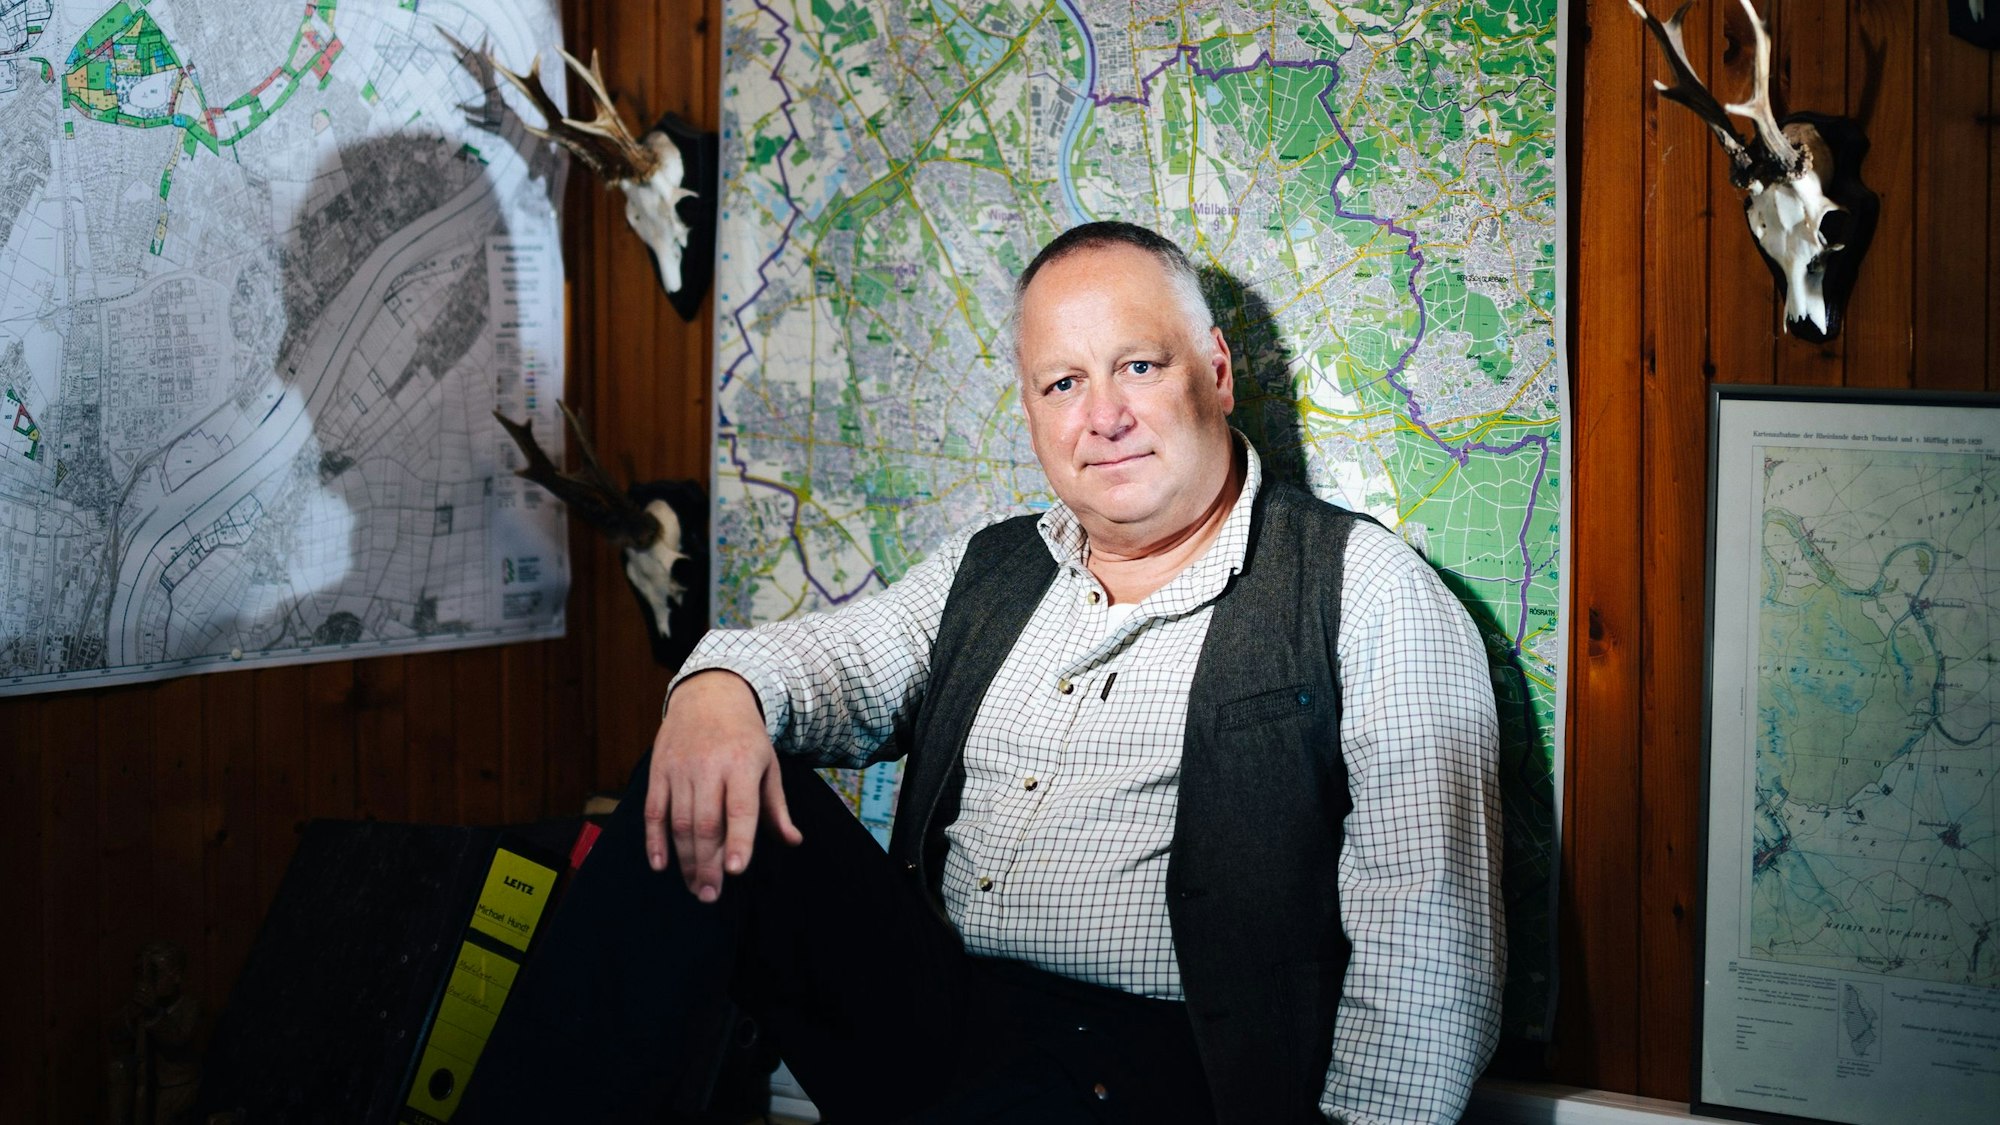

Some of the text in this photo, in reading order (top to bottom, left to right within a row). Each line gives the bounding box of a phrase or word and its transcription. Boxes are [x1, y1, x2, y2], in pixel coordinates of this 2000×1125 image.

[1529, 607, 1556, 617] RÖSRATH
[503, 875, 535, 896] LEITZ
[479, 903, 506, 922] Michael
